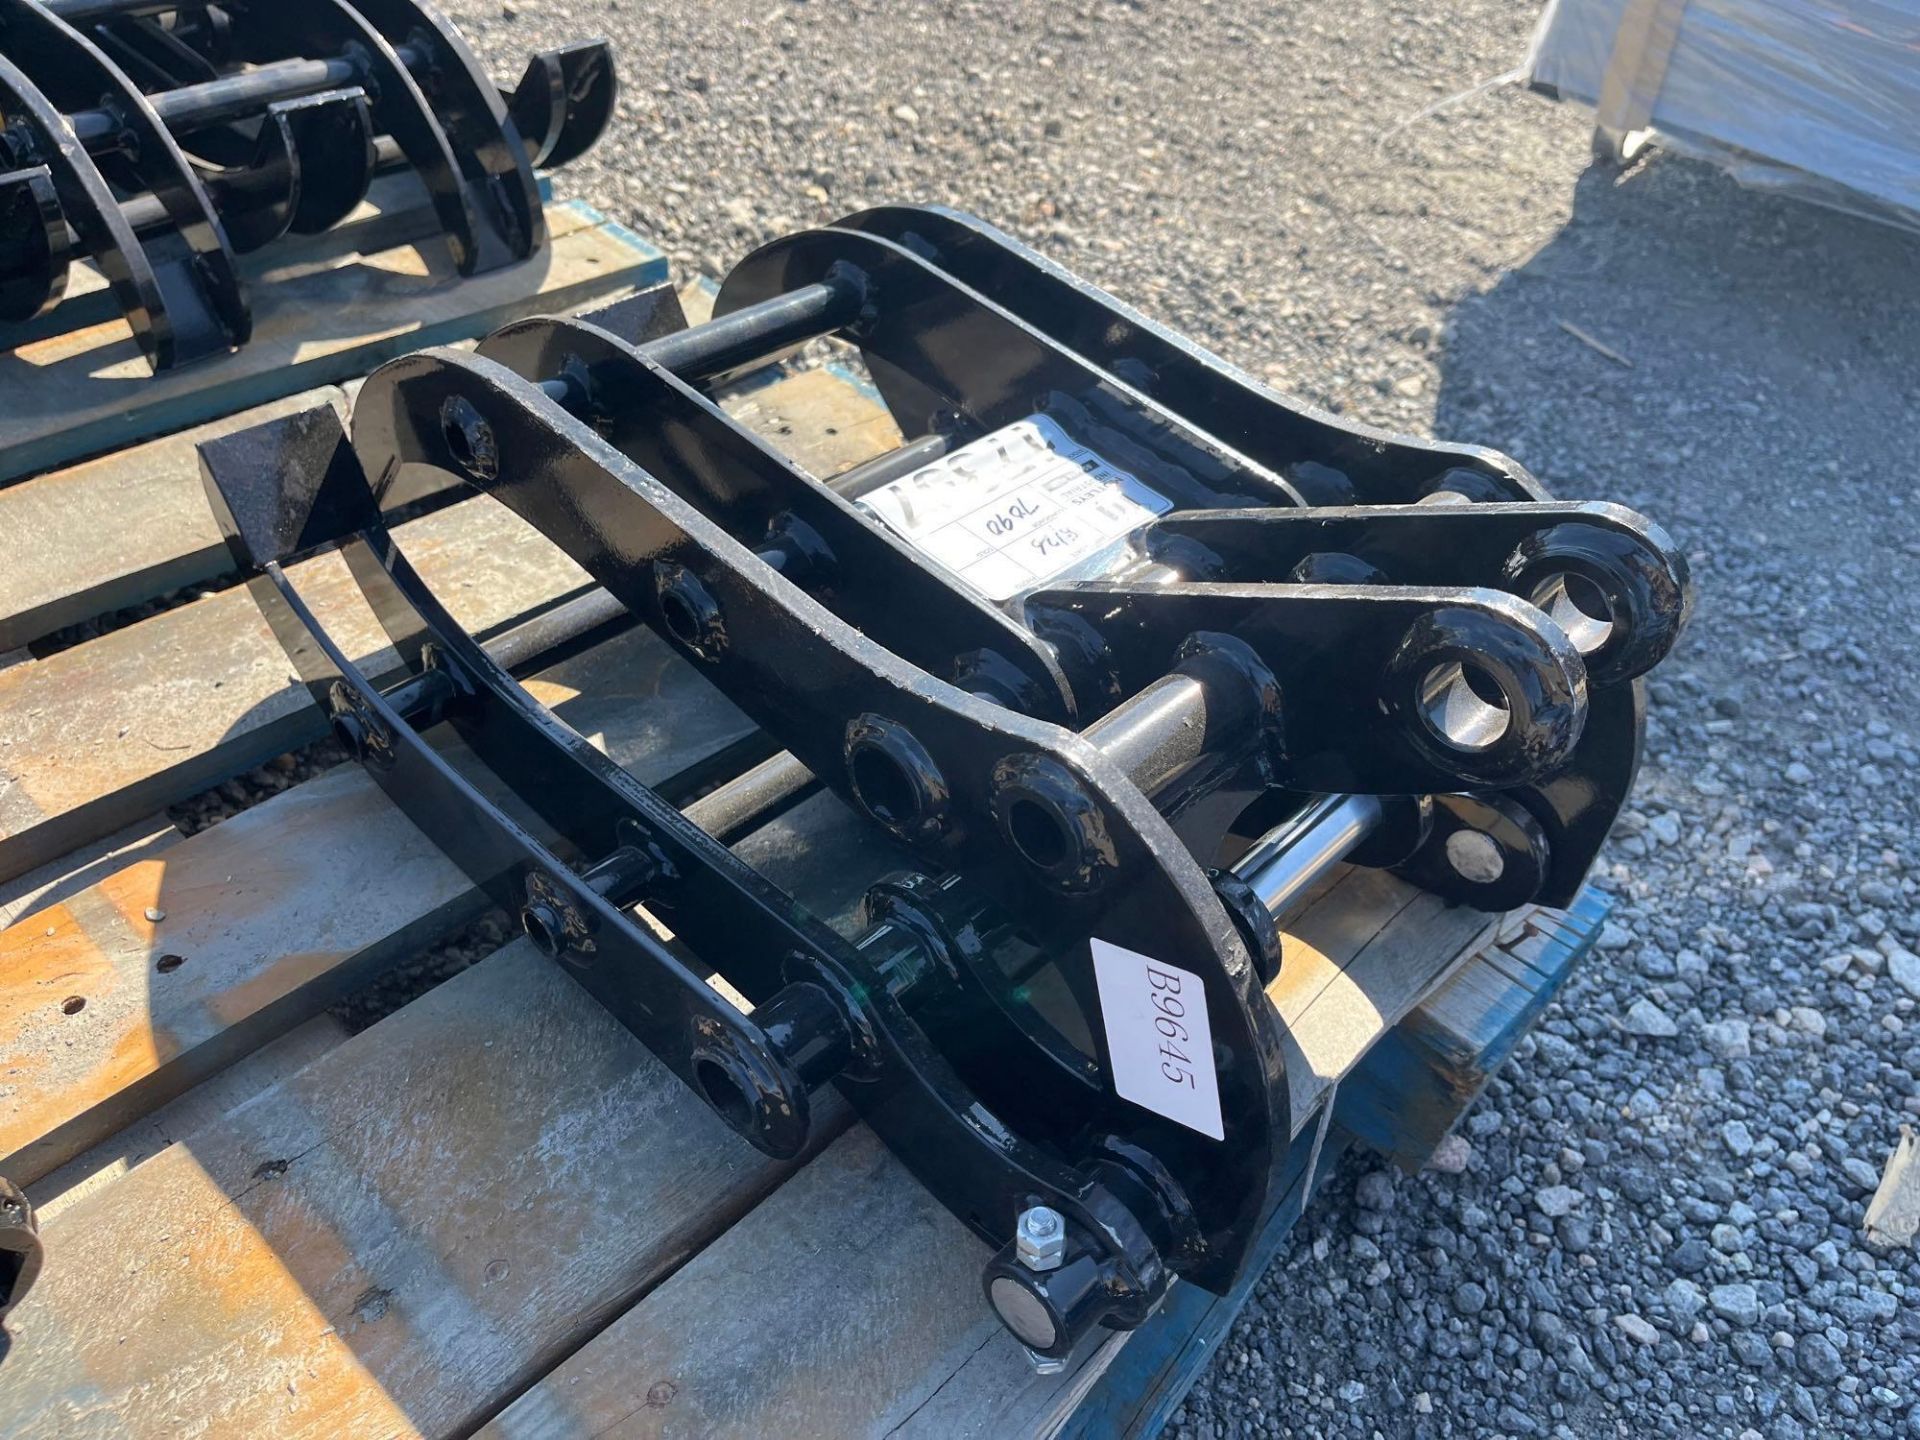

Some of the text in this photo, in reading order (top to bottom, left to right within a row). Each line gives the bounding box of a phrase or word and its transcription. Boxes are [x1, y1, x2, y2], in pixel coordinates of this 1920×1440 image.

[1060, 470, 1110, 500] INDSTRIAL
[985, 497, 1040, 537] 7090
[1146, 964, 1196, 1090] B9645
